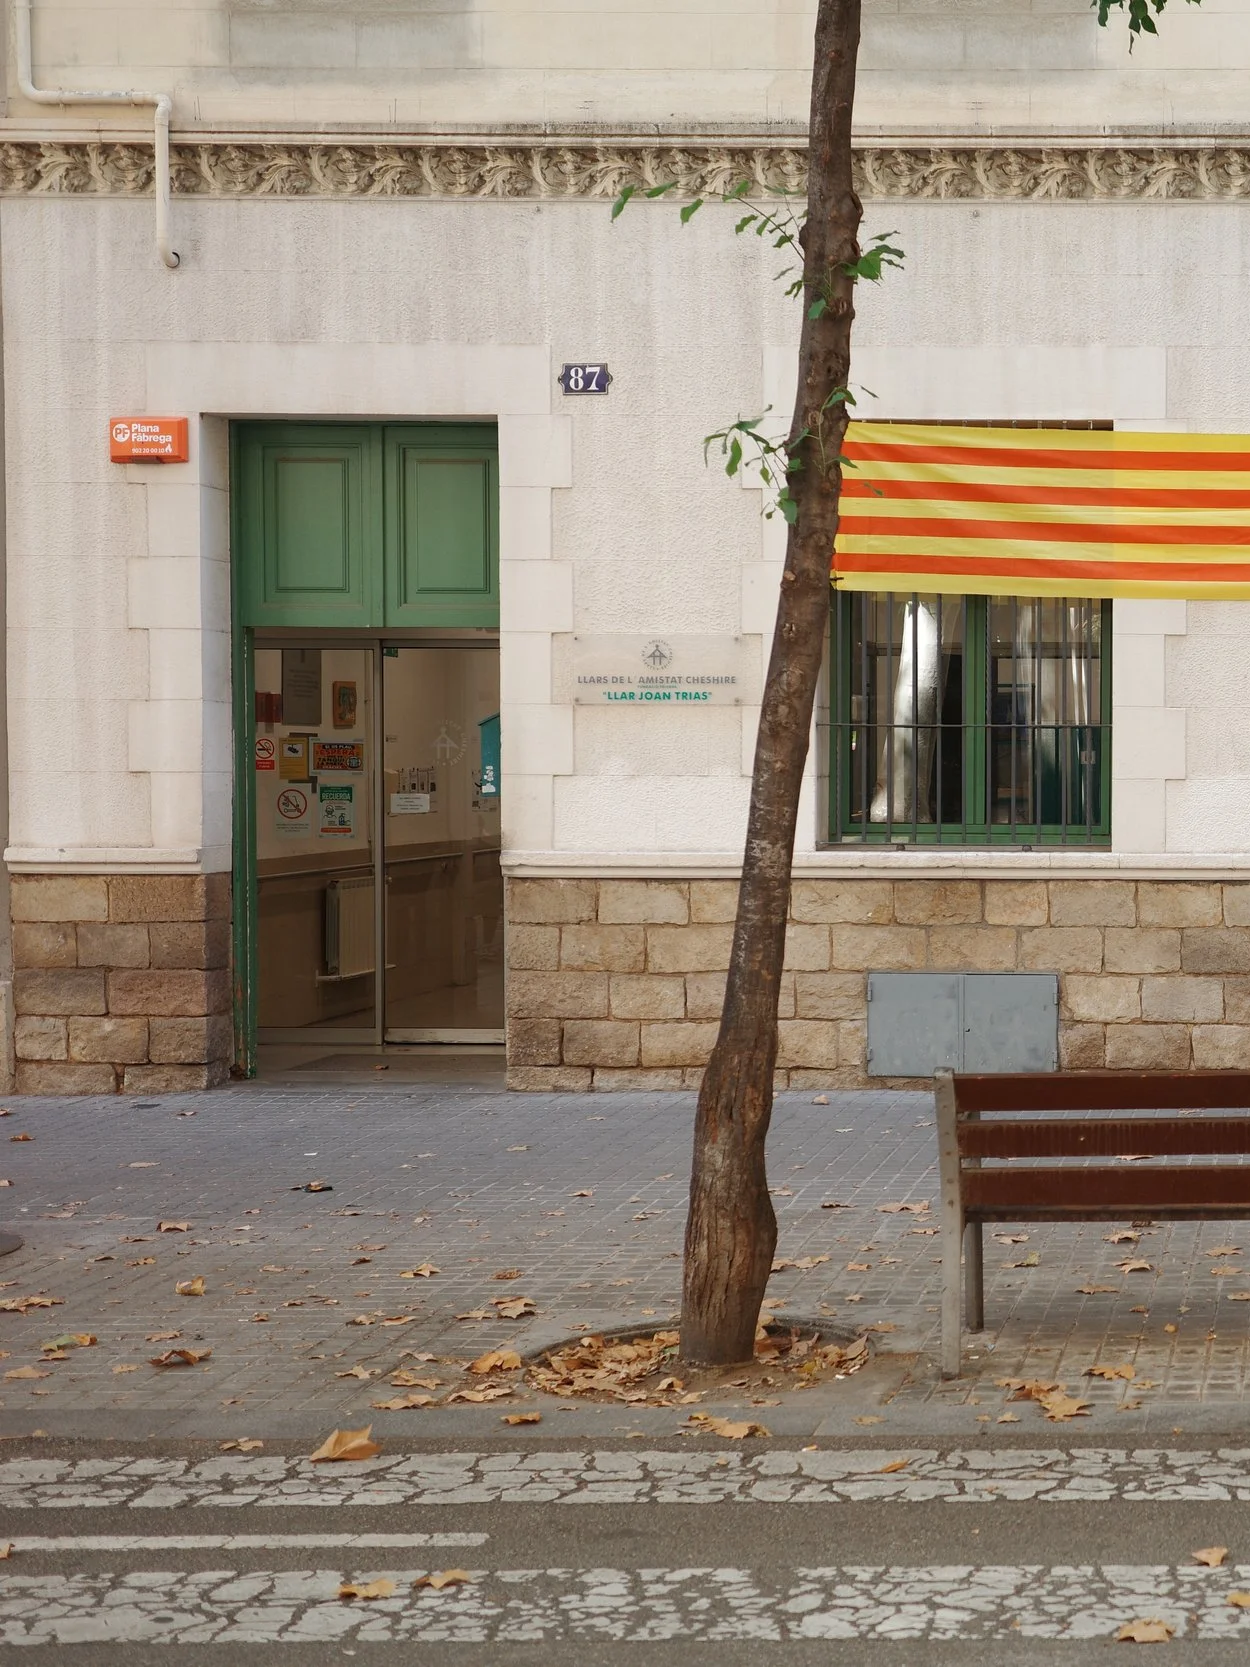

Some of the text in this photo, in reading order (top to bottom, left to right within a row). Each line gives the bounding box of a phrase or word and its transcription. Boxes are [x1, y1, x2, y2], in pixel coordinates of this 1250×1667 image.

[569, 366, 601, 391] 87
[114, 427, 129, 439] PF
[131, 423, 160, 433] Plana
[577, 676, 609, 684] LLARS
[611, 676, 625, 684] DE
[638, 676, 683, 684] AMISTAT
[685, 676, 737, 685] CHESHIRE
[638, 691, 671, 701] JOAN
